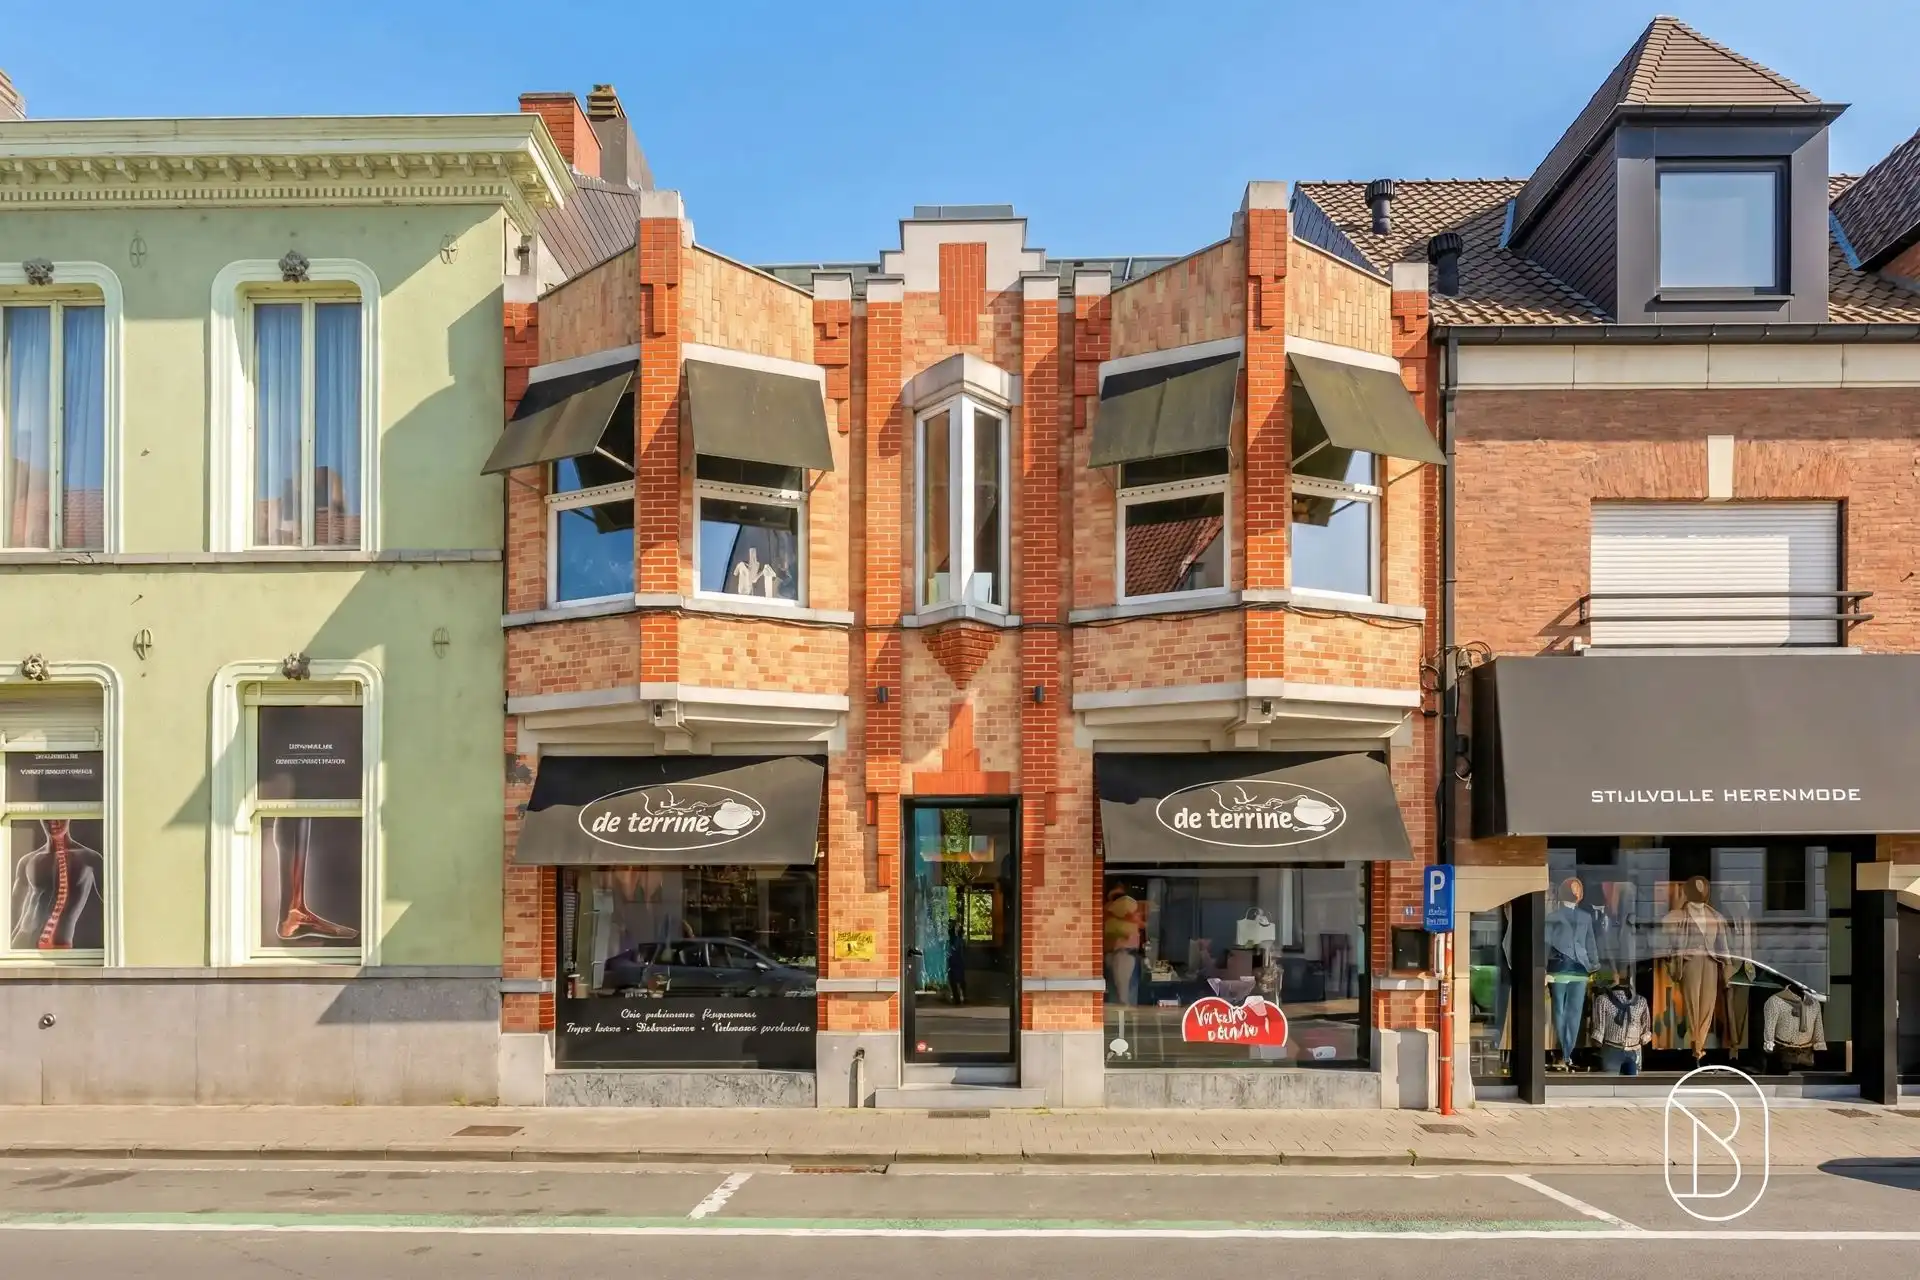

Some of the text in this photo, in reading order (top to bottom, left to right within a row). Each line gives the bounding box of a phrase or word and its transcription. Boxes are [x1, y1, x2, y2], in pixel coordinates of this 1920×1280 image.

[1591, 788, 1861, 803] STIJLVOLLE HERENMODE
[592, 811, 710, 833] de terrine
[1174, 807, 1294, 830] de terrine
[1429, 870, 1446, 905] P
